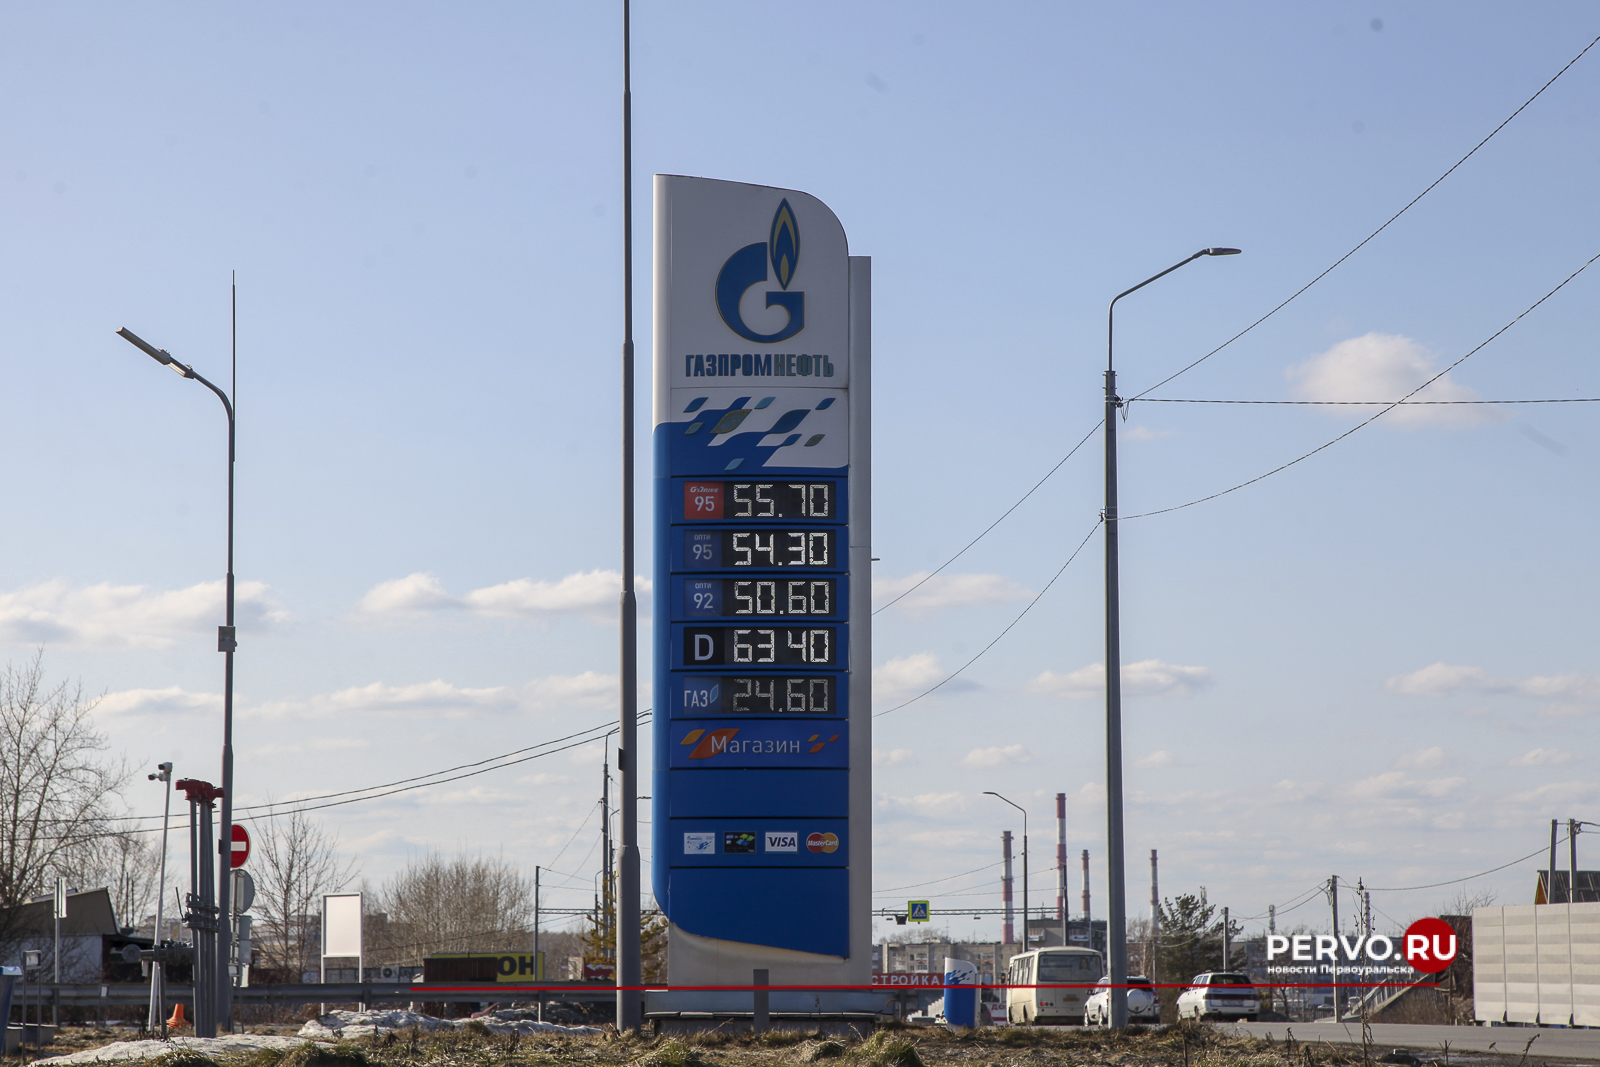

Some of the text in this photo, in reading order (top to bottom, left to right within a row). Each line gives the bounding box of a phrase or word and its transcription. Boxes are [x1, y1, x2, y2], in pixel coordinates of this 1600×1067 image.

[685, 353, 835, 378] ГАЗПРОМНЕФТЬ
[694, 496, 715, 511] 95
[733, 484, 829, 517] 55.70
[692, 544, 713, 560] 95
[732, 532, 828, 566] 54.30
[693, 593, 714, 609] 92
[734, 581, 830, 614] 50.60
[694, 634, 714, 661] D
[684, 690, 708, 708] ГАЗ
[732, 678, 829, 712] 24.60
[711, 735, 800, 753] Магазин
[767, 836, 796, 848] VISA
